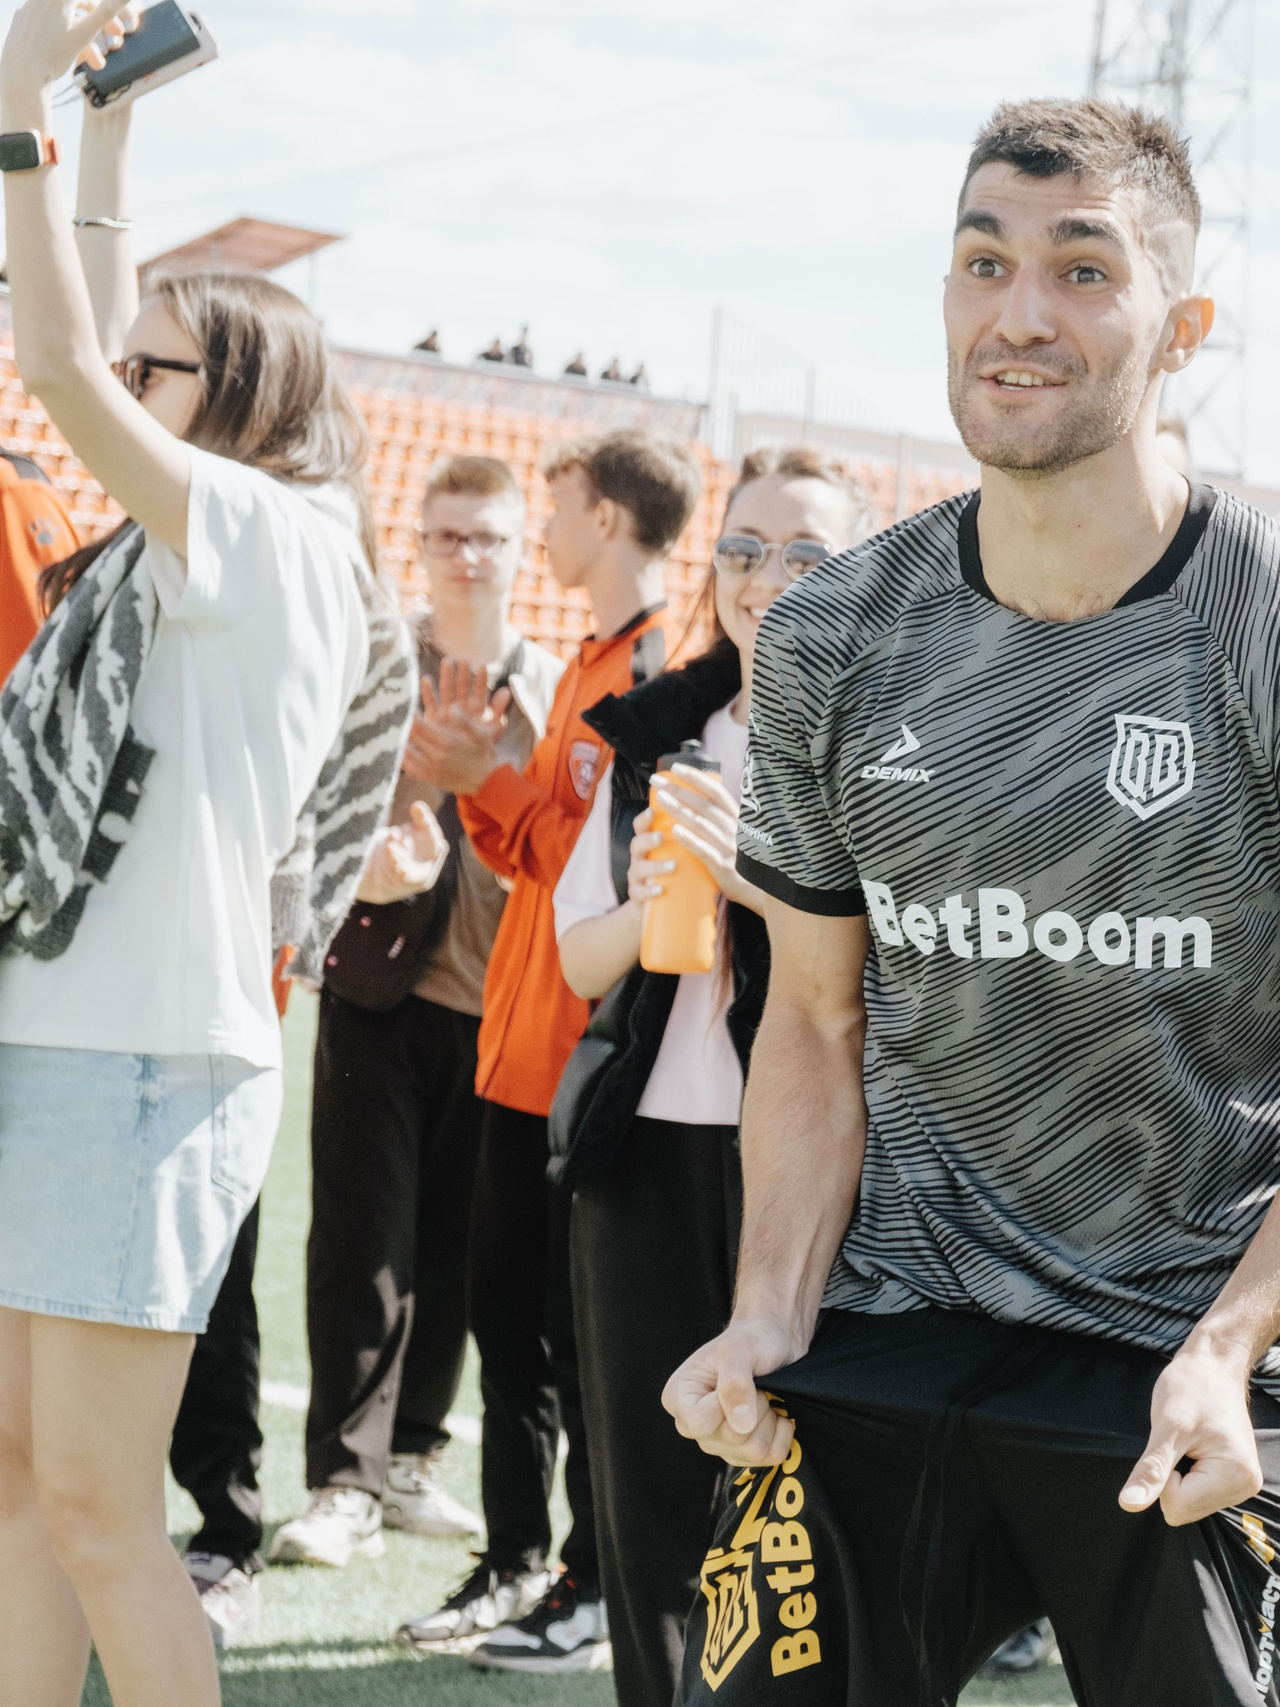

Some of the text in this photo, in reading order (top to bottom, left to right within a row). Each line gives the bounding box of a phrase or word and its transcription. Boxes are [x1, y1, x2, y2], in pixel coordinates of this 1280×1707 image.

[861, 765, 936, 782] DEMIX
[739, 821, 774, 846] ЕНИНГА
[861, 880, 1212, 969] BetBoom
[760, 1390, 822, 1677] BetBoo
